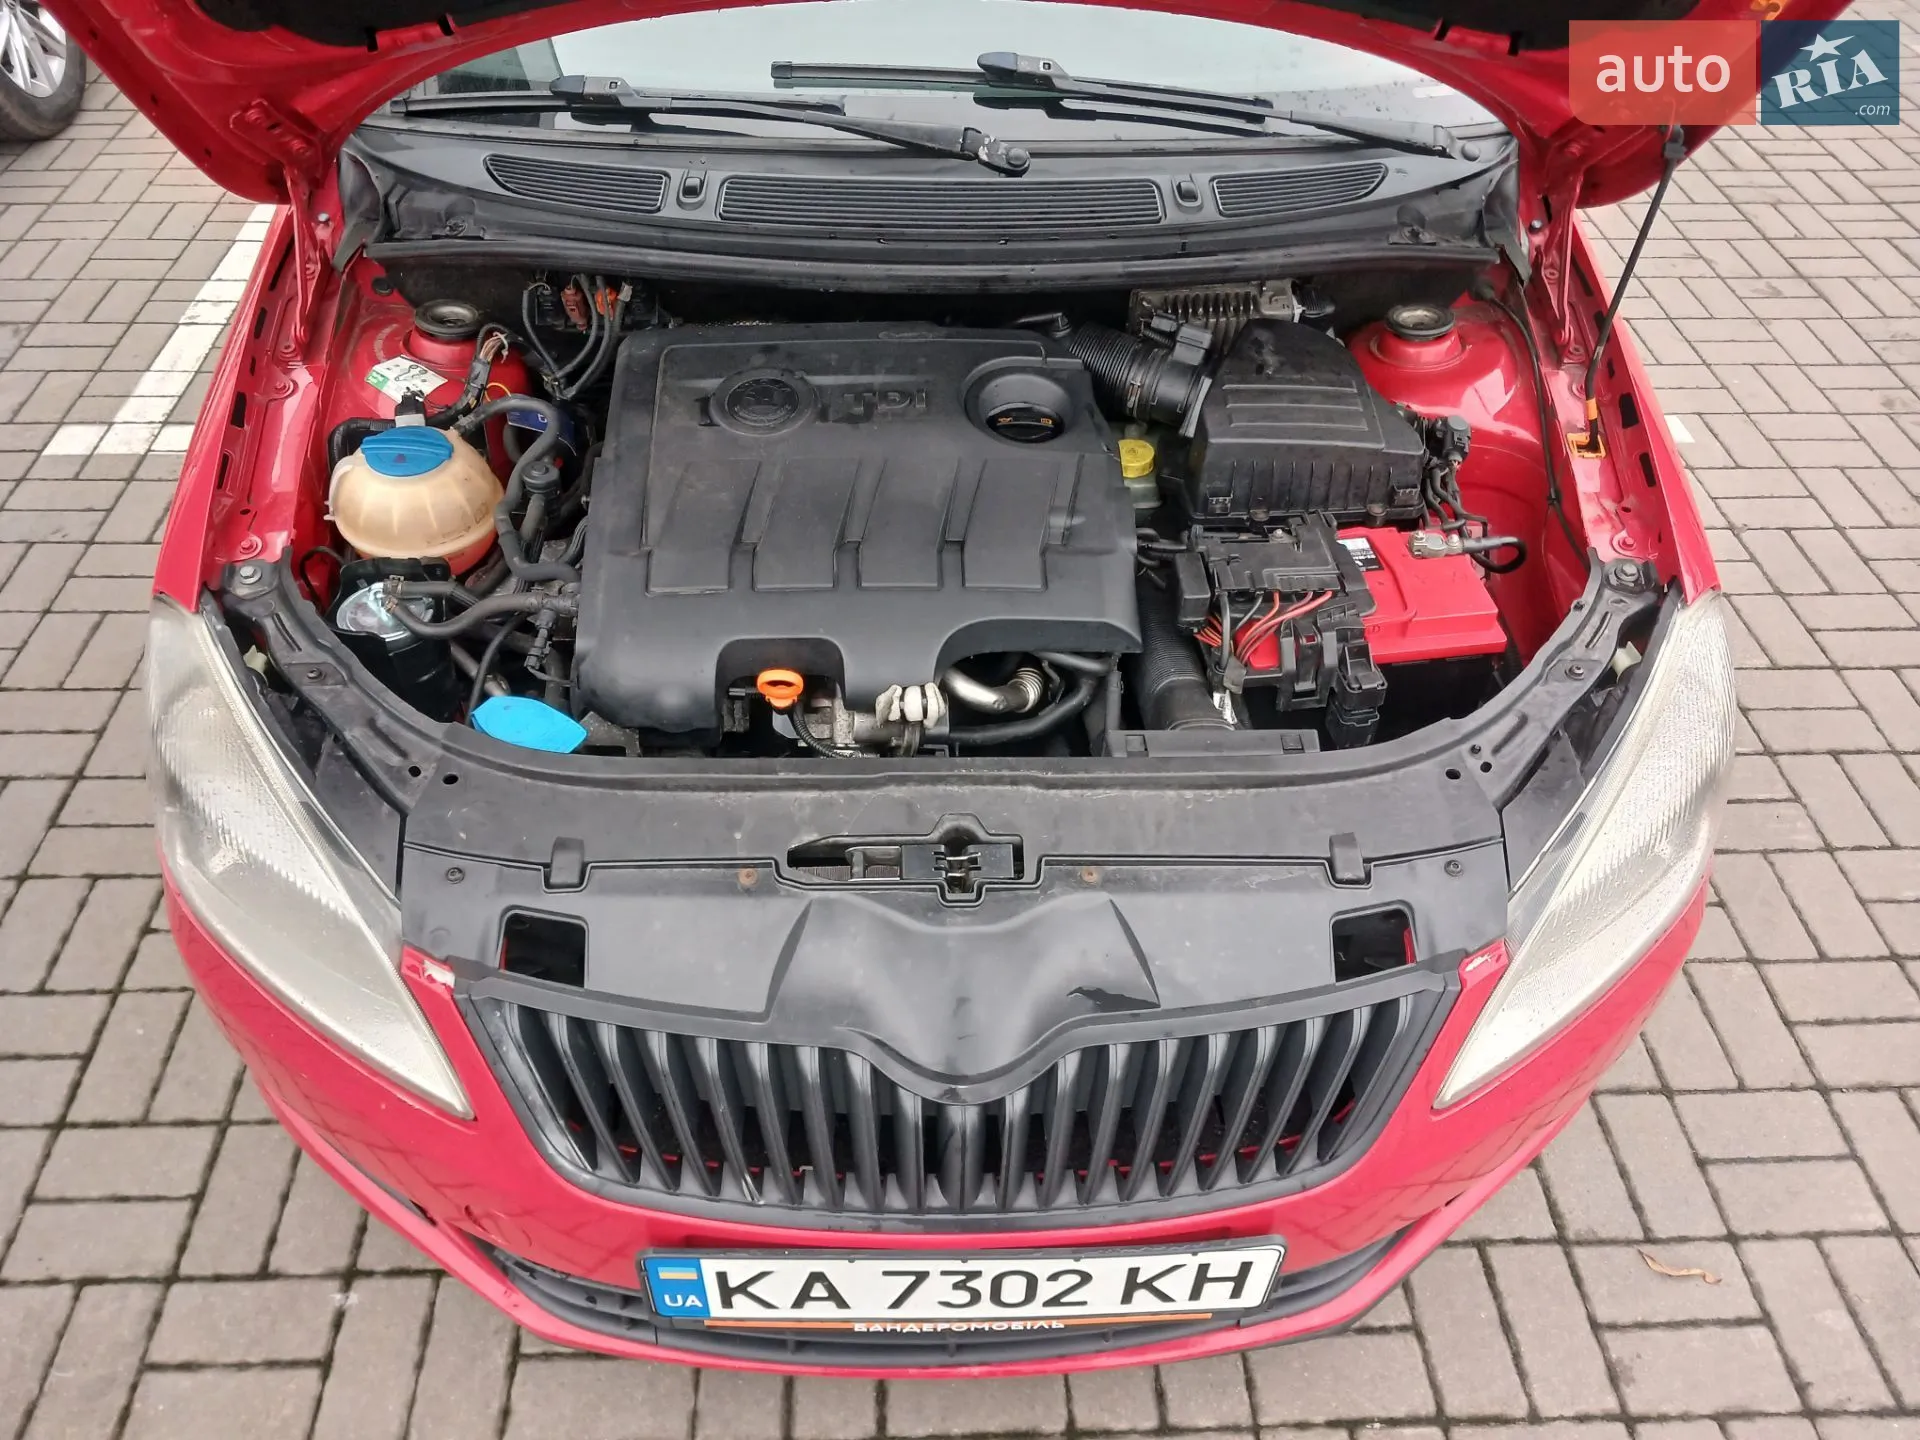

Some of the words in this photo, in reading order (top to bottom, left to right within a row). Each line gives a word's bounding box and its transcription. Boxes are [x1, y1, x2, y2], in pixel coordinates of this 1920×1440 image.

[843, 388, 928, 415] TDI
[715, 1270, 852, 1310] KA
[881, 1268, 1094, 1310] 7302
[1120, 1261, 1253, 1306] KH
[663, 1293, 703, 1307] UA
[853, 1320, 1065, 1334] БАНДЕРОМОБІЛЬ
